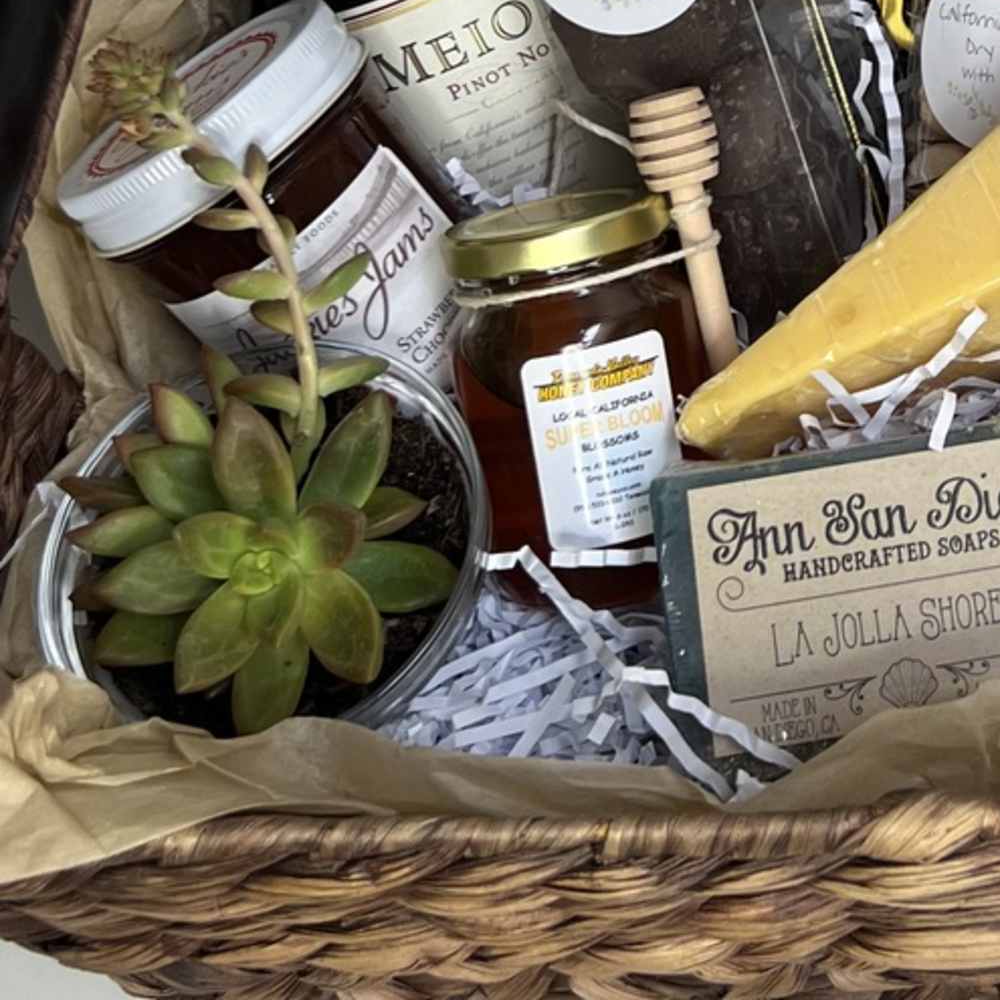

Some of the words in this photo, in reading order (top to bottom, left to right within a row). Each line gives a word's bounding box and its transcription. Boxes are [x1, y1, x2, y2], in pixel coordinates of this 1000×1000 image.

[965, 37, 995, 62] Dry
[446, 63, 513, 102] PINOT
[364, 206, 434, 340] Jams
[706, 508, 814, 575] Ann
[822, 492, 918, 546] San
[783, 541, 931, 583] HANDCRAFTED
[938, 528, 1000, 556] SOAPS
[770, 620, 814, 668] LA
[823, 603, 913, 658] JOLLA
